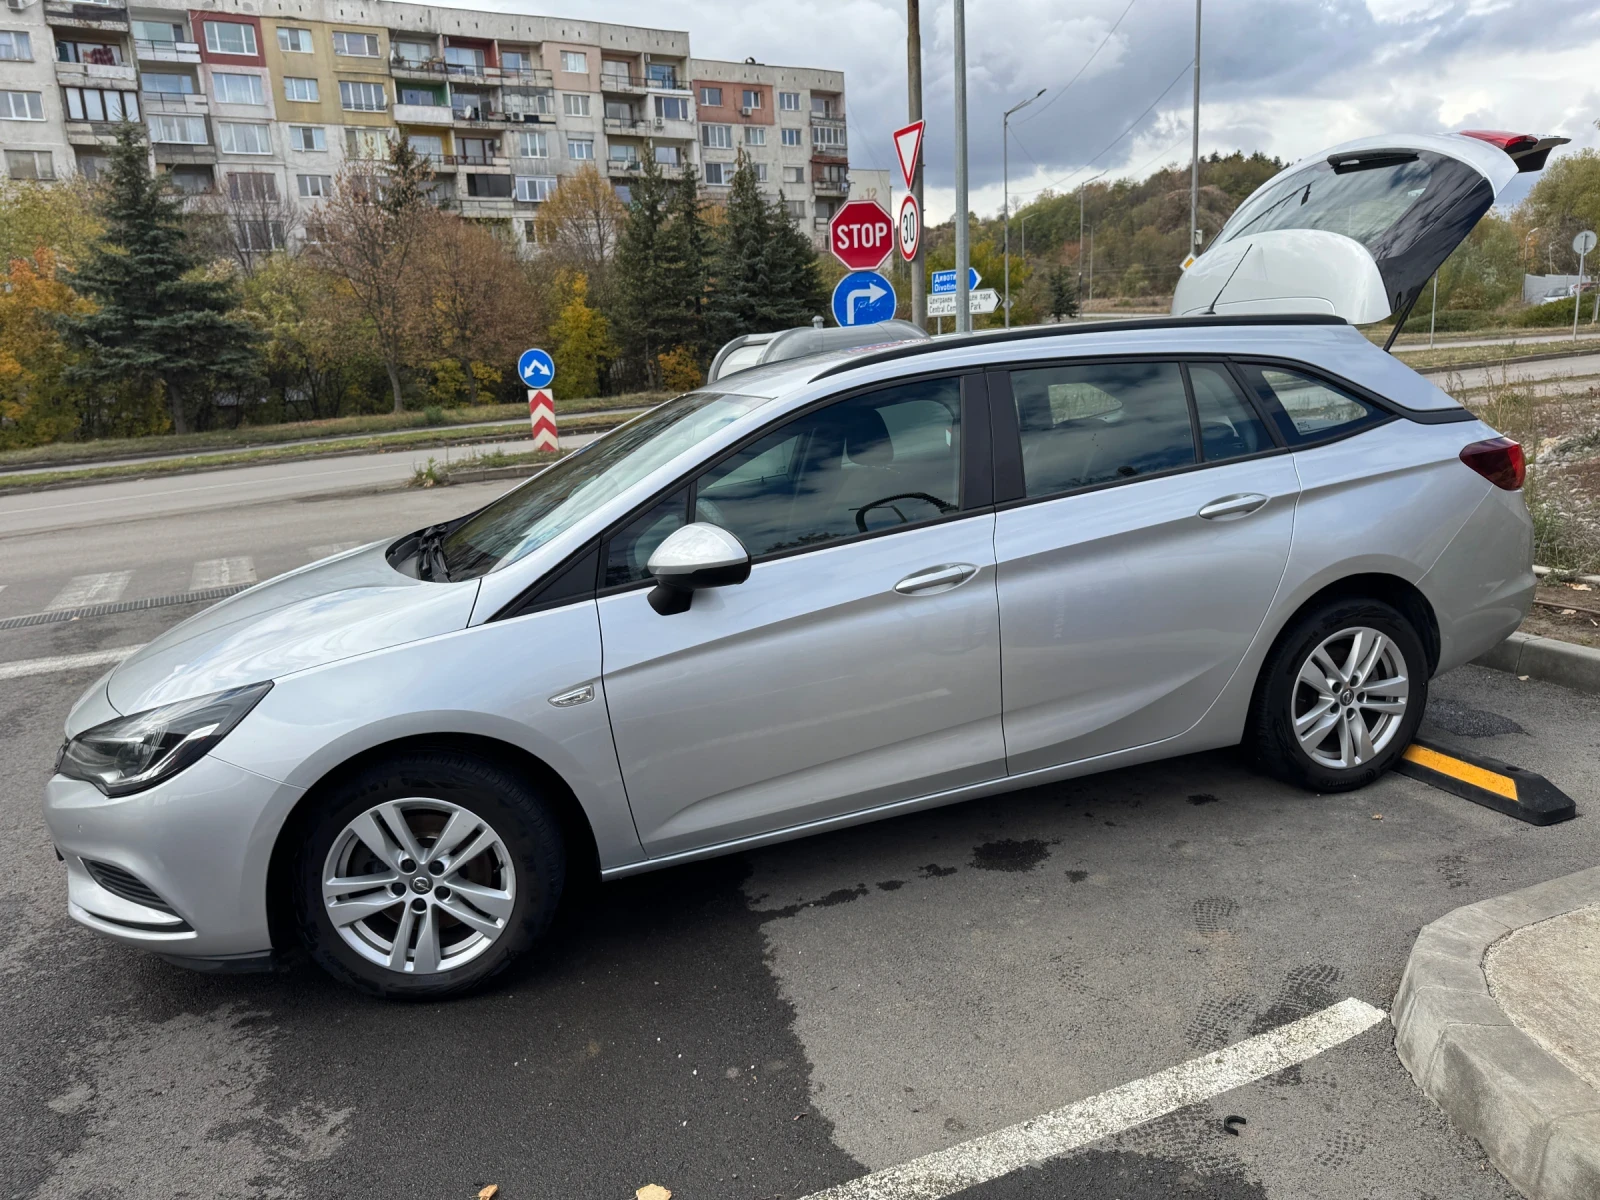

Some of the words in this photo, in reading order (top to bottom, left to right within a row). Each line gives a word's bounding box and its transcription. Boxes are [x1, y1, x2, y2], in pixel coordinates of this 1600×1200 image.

[837, 222, 887, 249] STOP
[902, 211, 915, 244] 30
[935, 274, 956, 283] Дивоти
[929, 305, 945, 313] Central
[970, 302, 981, 311] Park
